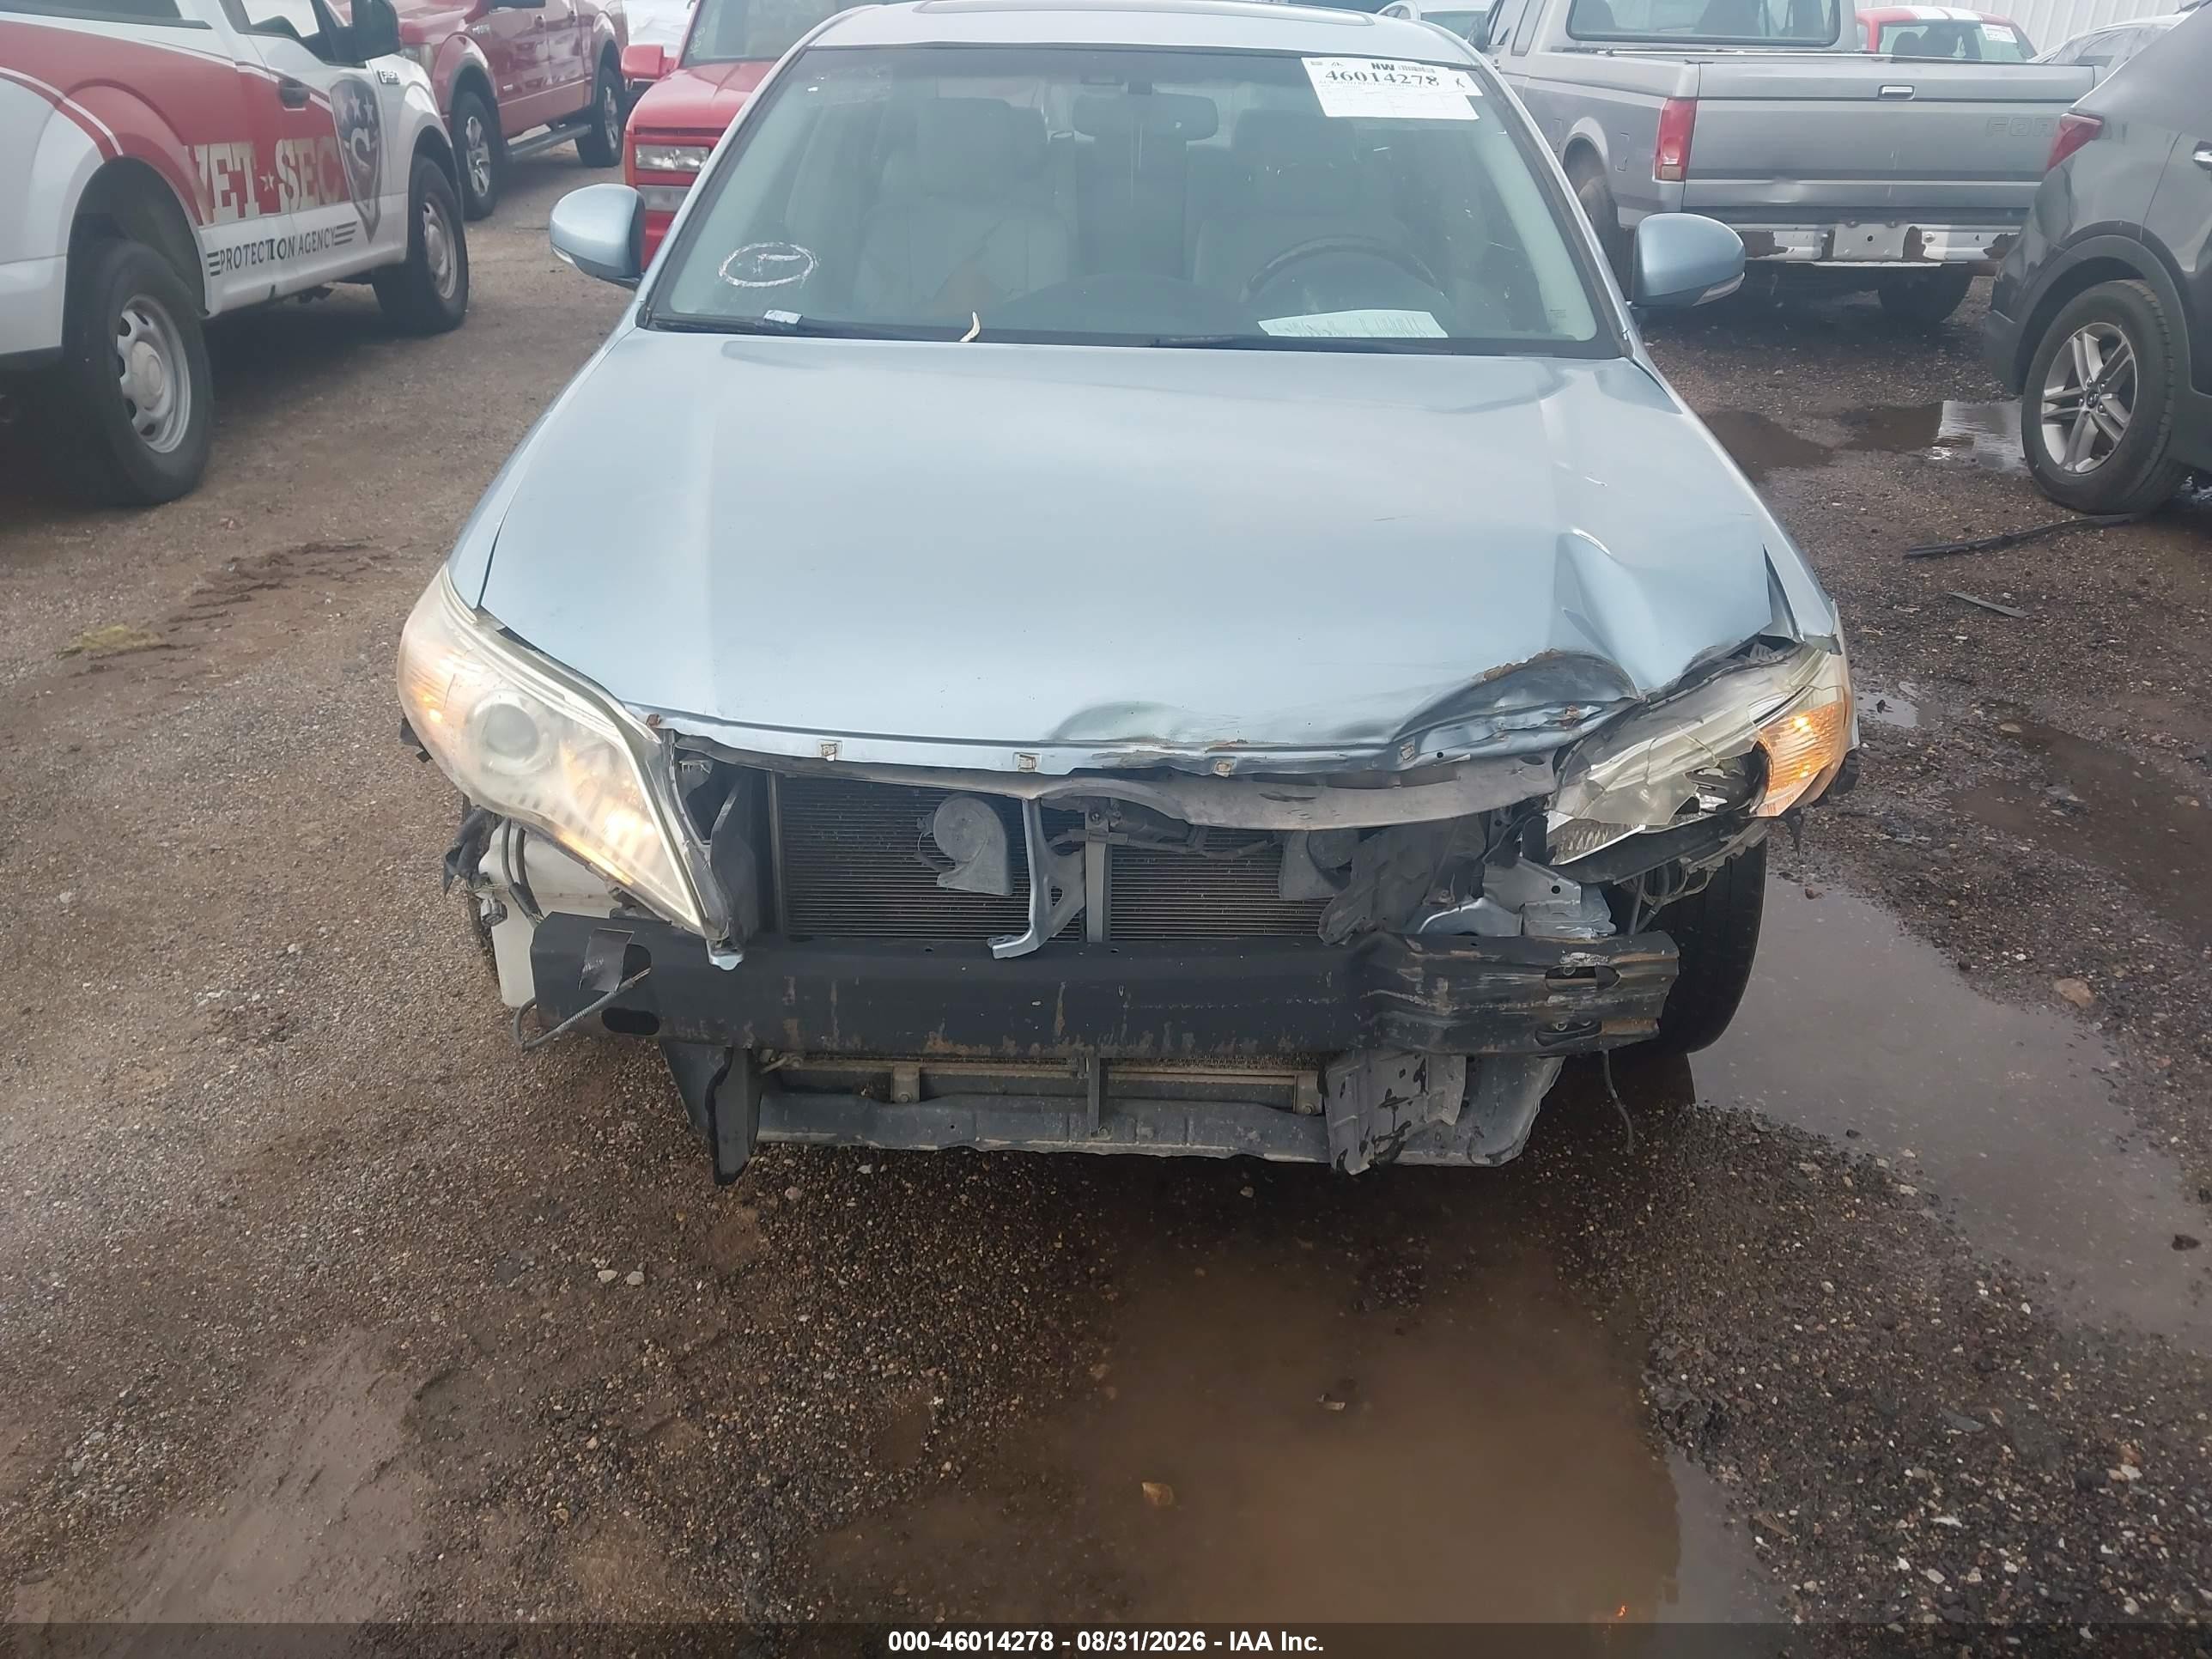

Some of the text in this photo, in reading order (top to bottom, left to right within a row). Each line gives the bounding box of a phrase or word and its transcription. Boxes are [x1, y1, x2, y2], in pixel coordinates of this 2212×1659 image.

[1325, 70, 1440, 87] 46014278
[219, 225, 337, 272] PROTECTION AGENCY
